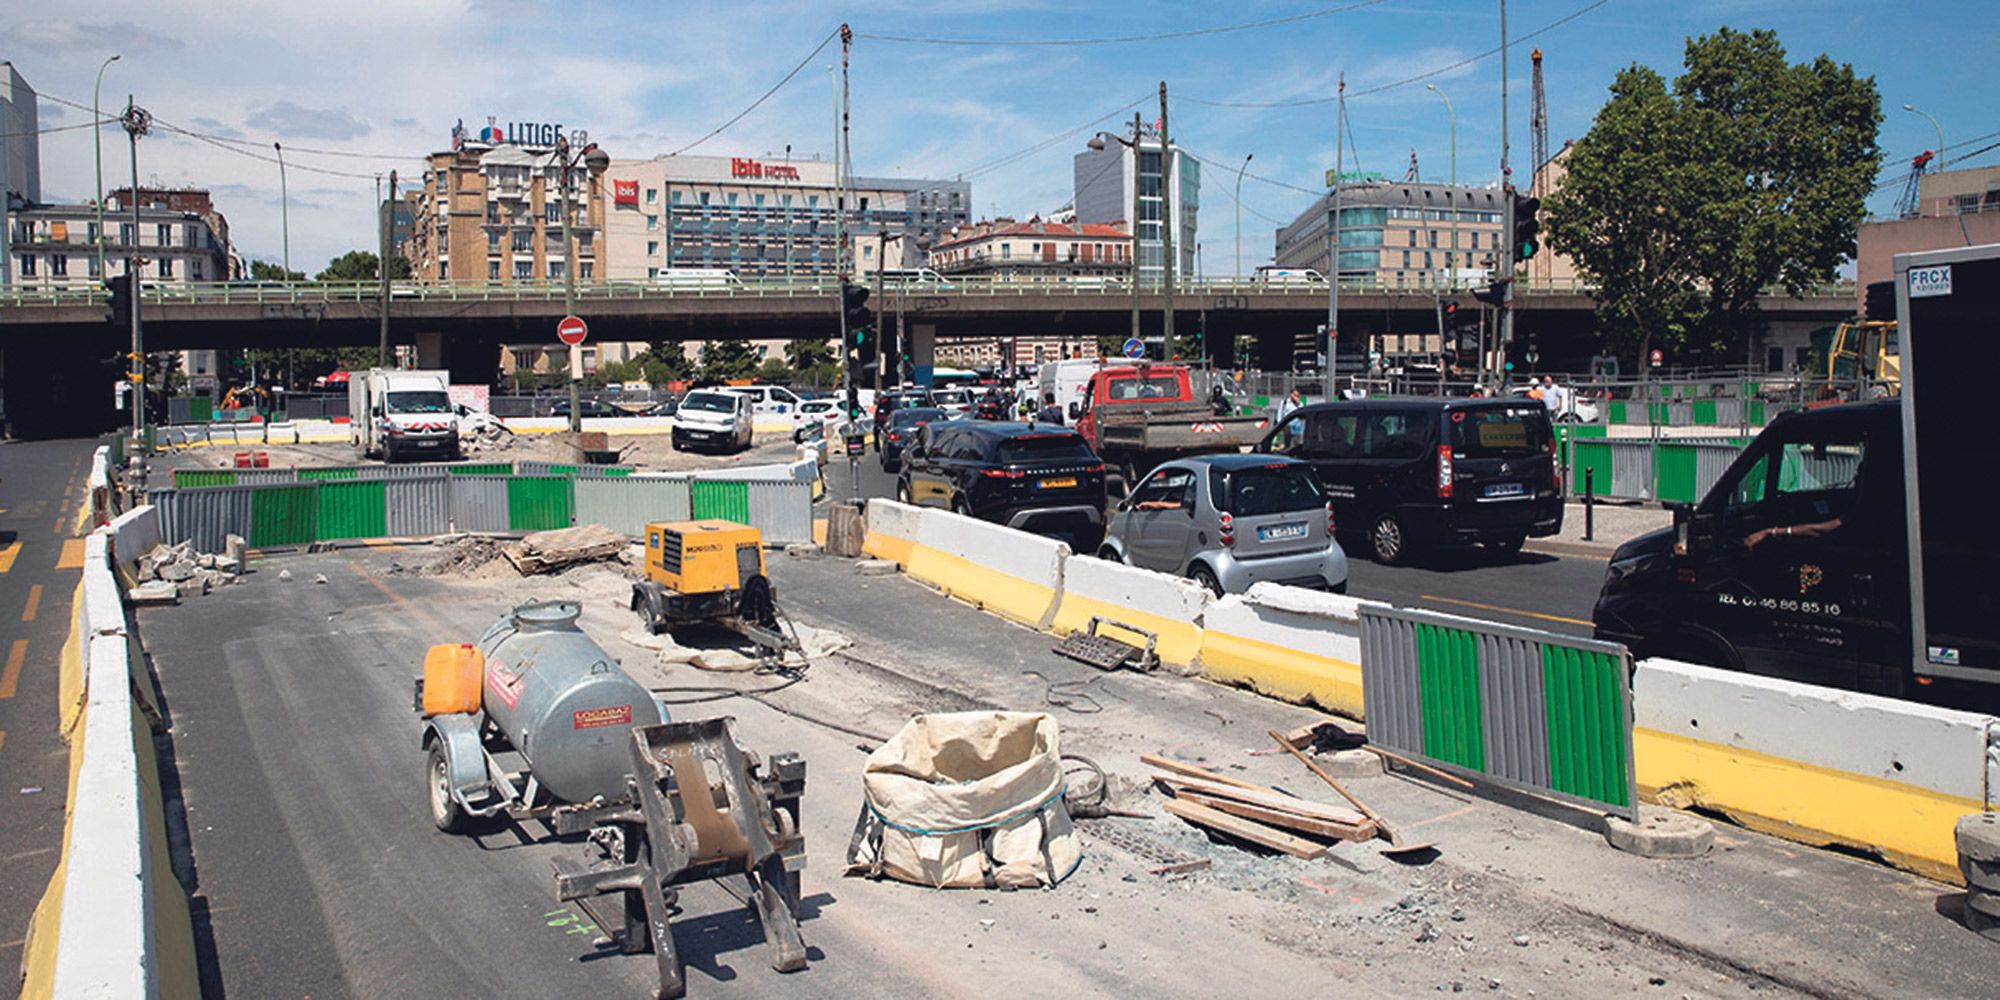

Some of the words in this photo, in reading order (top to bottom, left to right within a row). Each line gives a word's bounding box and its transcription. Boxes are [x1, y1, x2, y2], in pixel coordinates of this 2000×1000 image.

[731, 157, 763, 177] ibis
[764, 165, 799, 180] HOTEL
[617, 184, 635, 197] ibis
[1911, 269, 1949, 284] FRCX
[1801, 601, 1821, 614] 85
